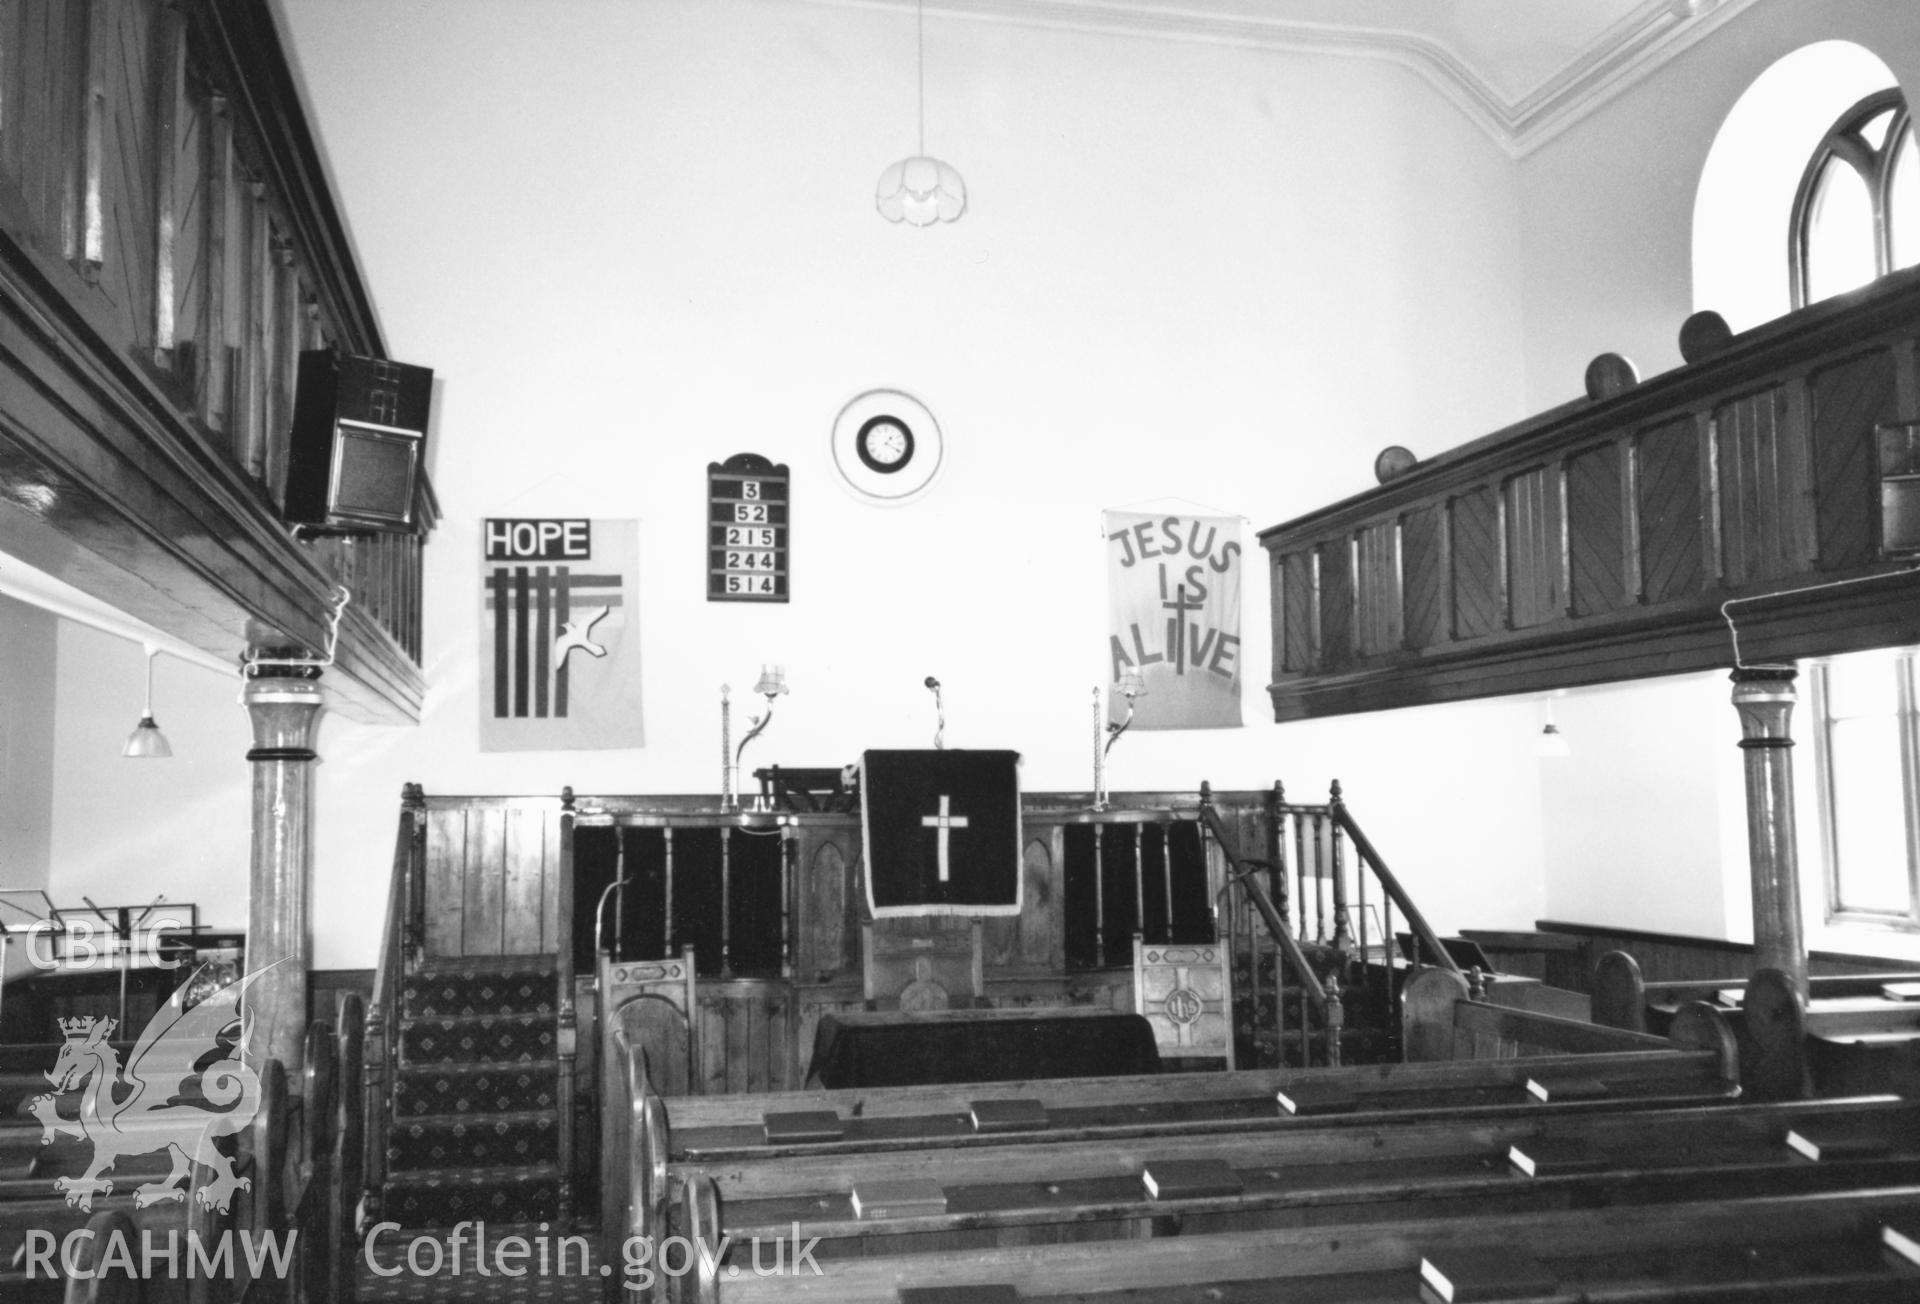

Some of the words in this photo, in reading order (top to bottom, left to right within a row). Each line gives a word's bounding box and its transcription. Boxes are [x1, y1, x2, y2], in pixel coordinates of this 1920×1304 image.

[746, 483, 757, 498] 3
[737, 506, 764, 521] 52
[486, 521, 587, 556] HOPE
[728, 529, 772, 545] 215
[1109, 516, 1242, 573] JESUS
[728, 553, 772, 568] 244
[728, 577, 772, 592] 514
[1159, 562, 1207, 603] IS
[1109, 617, 1241, 683] ALIVE
